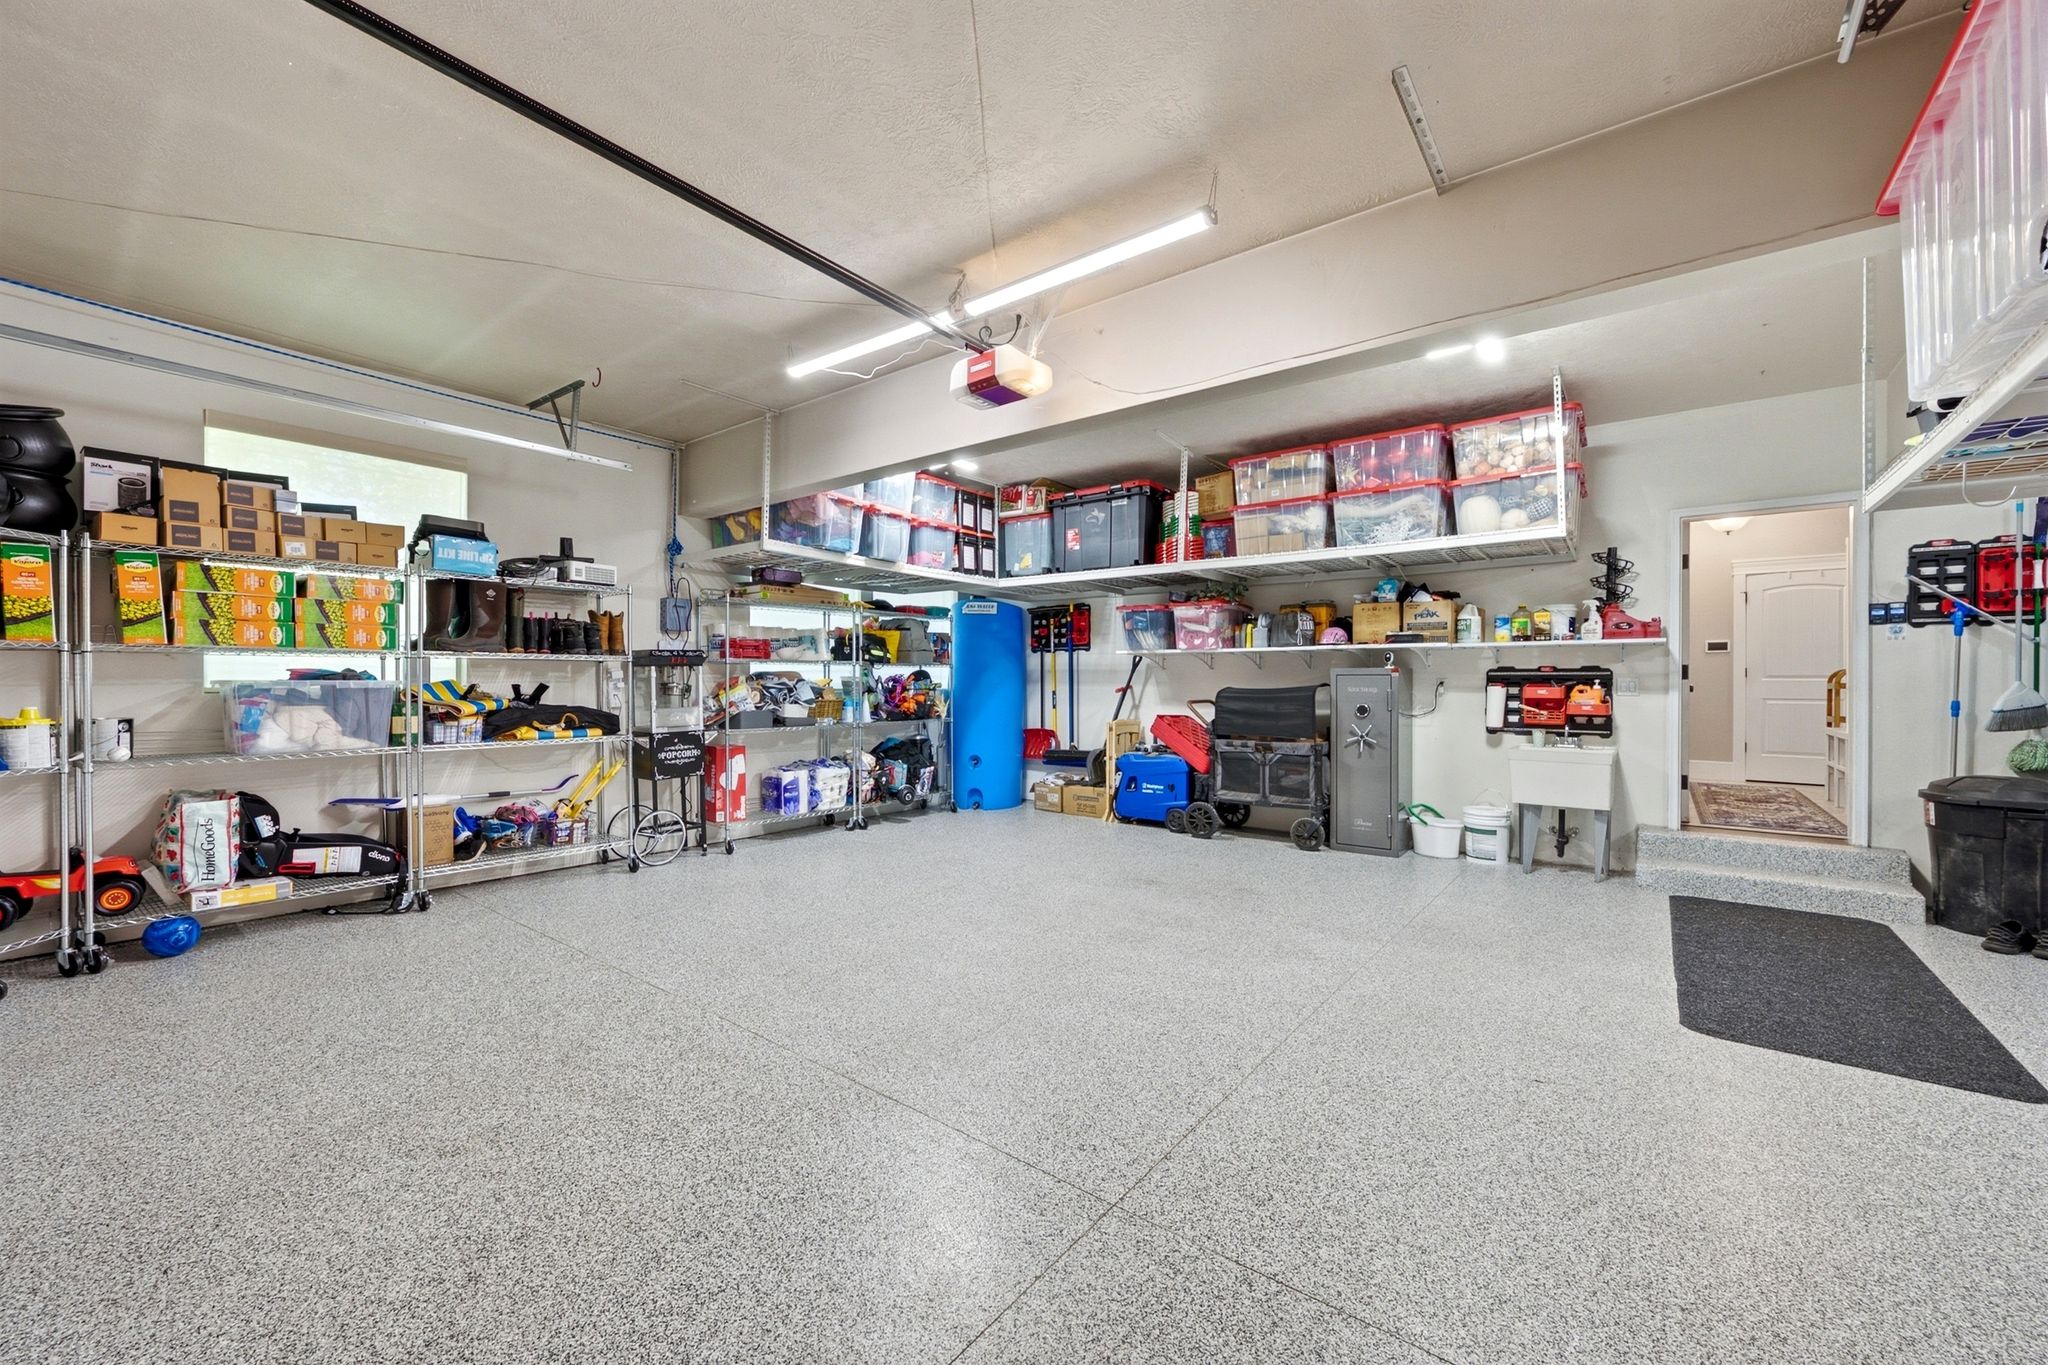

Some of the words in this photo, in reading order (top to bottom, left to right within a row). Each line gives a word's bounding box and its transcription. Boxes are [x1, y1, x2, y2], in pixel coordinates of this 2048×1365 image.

[437, 547, 456, 559] KIT
[457, 549, 479, 562] LINE
[480, 552, 495, 564] ZIP
[1414, 608, 1440, 620] PEAK
[661, 748, 698, 760] POPCORN
[200, 817, 217, 882] HomeGoods
[368, 850, 391, 863] diono
